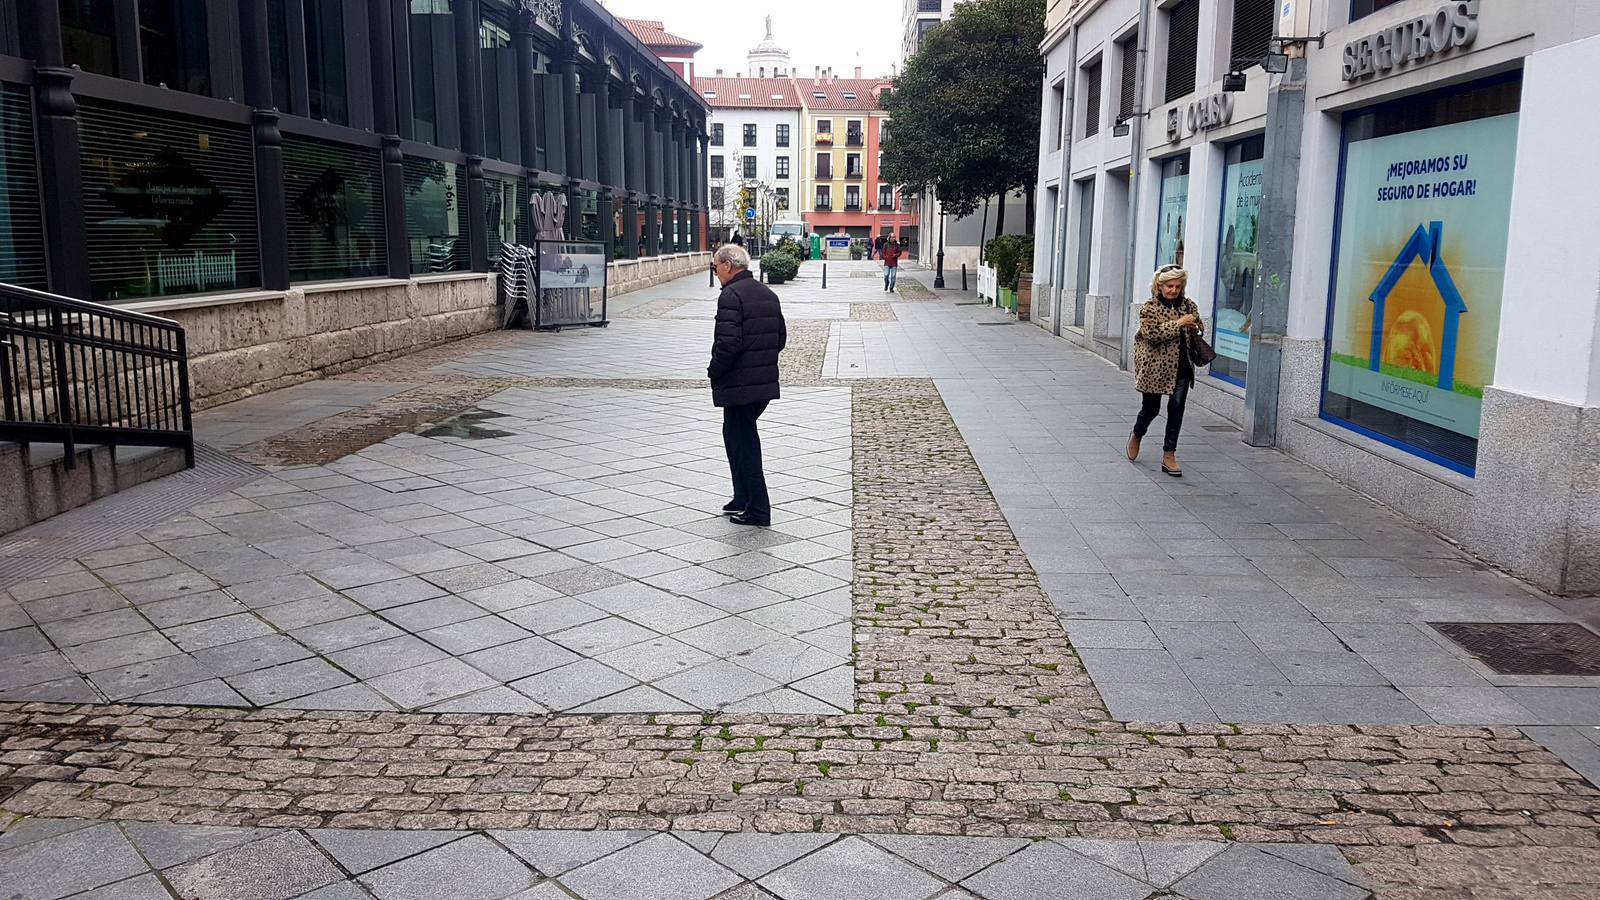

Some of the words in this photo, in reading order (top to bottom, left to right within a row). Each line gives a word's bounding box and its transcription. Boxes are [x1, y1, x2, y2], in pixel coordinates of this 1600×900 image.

[1342, 1, 1479, 81] SEGUROS
[1187, 92, 1234, 131] OCASO
[1386, 156, 1450, 181] ¡MEJORAMOS
[1453, 154, 1468, 171] SU
[1377, 185, 1414, 201] SEGURO
[1416, 183, 1431, 199] DE
[1432, 180, 1477, 198] HOGAR!
